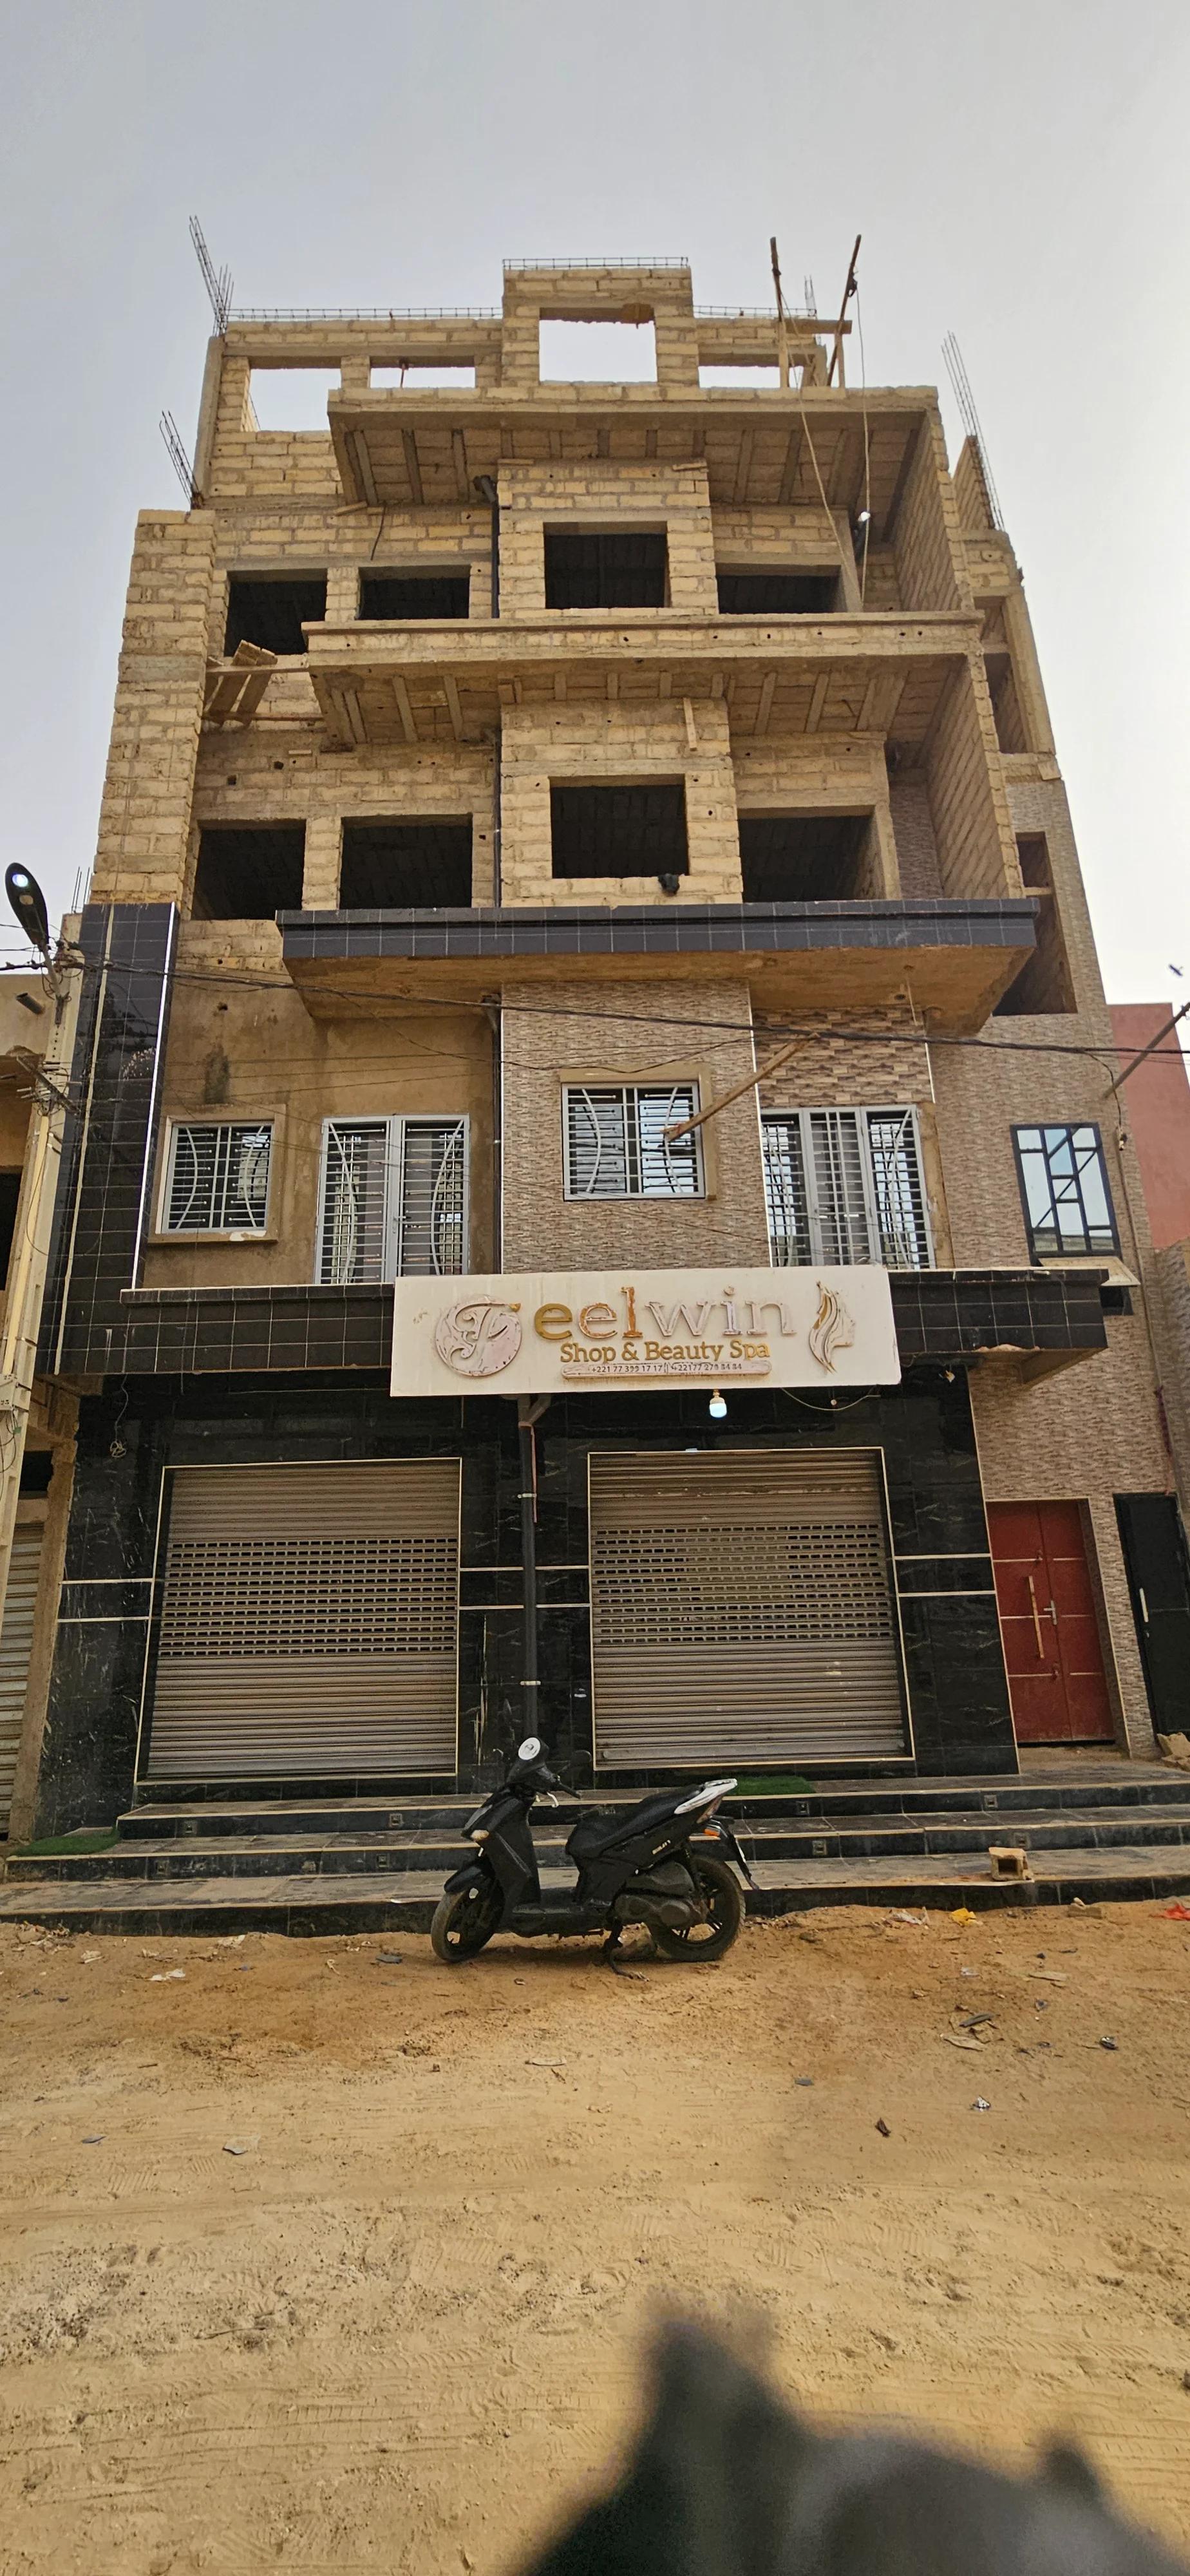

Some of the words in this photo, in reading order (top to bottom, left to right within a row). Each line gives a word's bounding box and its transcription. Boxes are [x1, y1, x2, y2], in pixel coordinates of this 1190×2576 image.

[560, 1341, 616, 1363] Shop
[621, 1341, 639, 1361] &
[644, 1340, 724, 1361] Beauty
[730, 1339, 770, 1361] Spa
